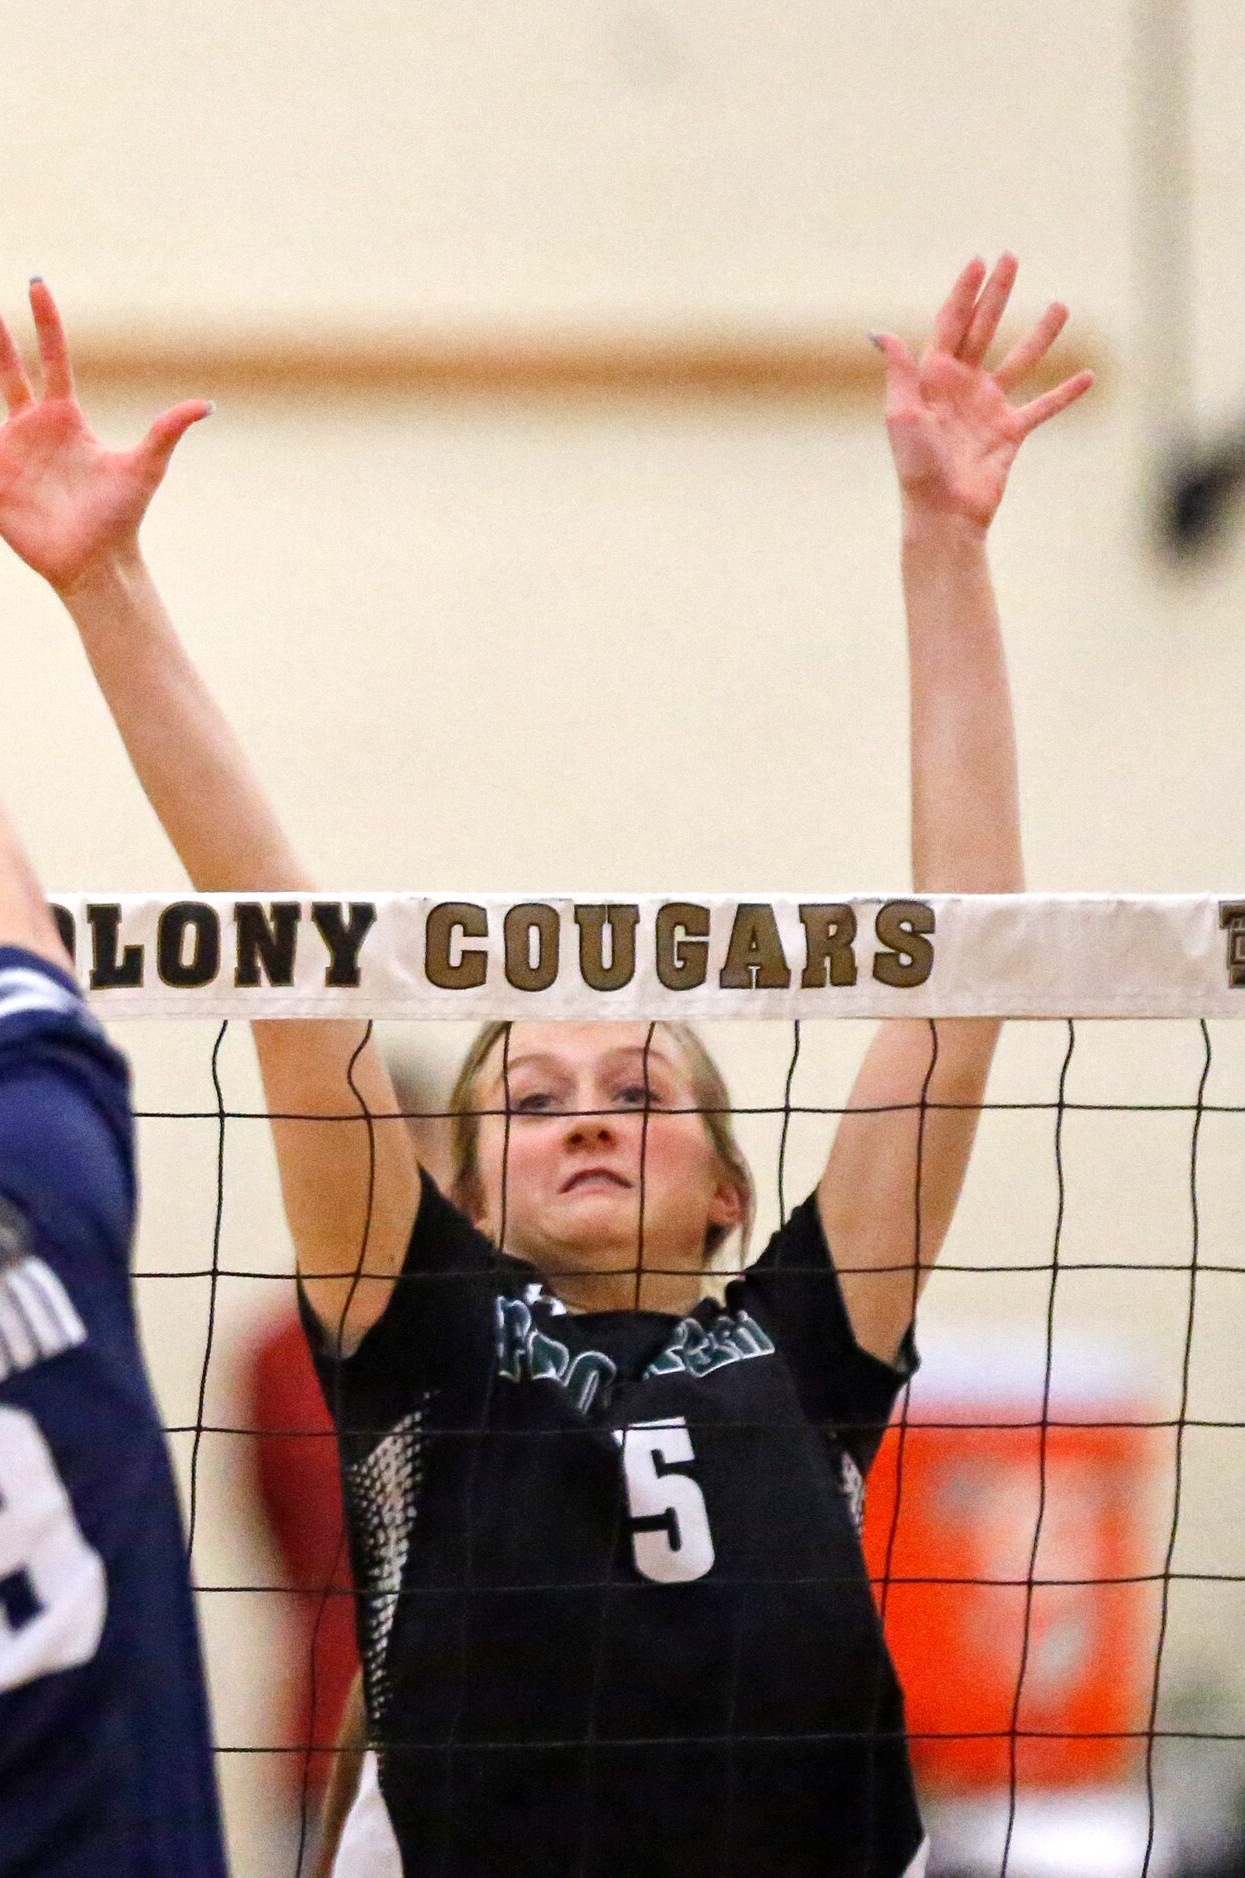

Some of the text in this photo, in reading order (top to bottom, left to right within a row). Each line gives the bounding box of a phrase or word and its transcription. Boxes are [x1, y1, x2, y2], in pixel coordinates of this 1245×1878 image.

[45, 900, 936, 992] LONY COUGARS
[612, 1416, 715, 1583] 5
